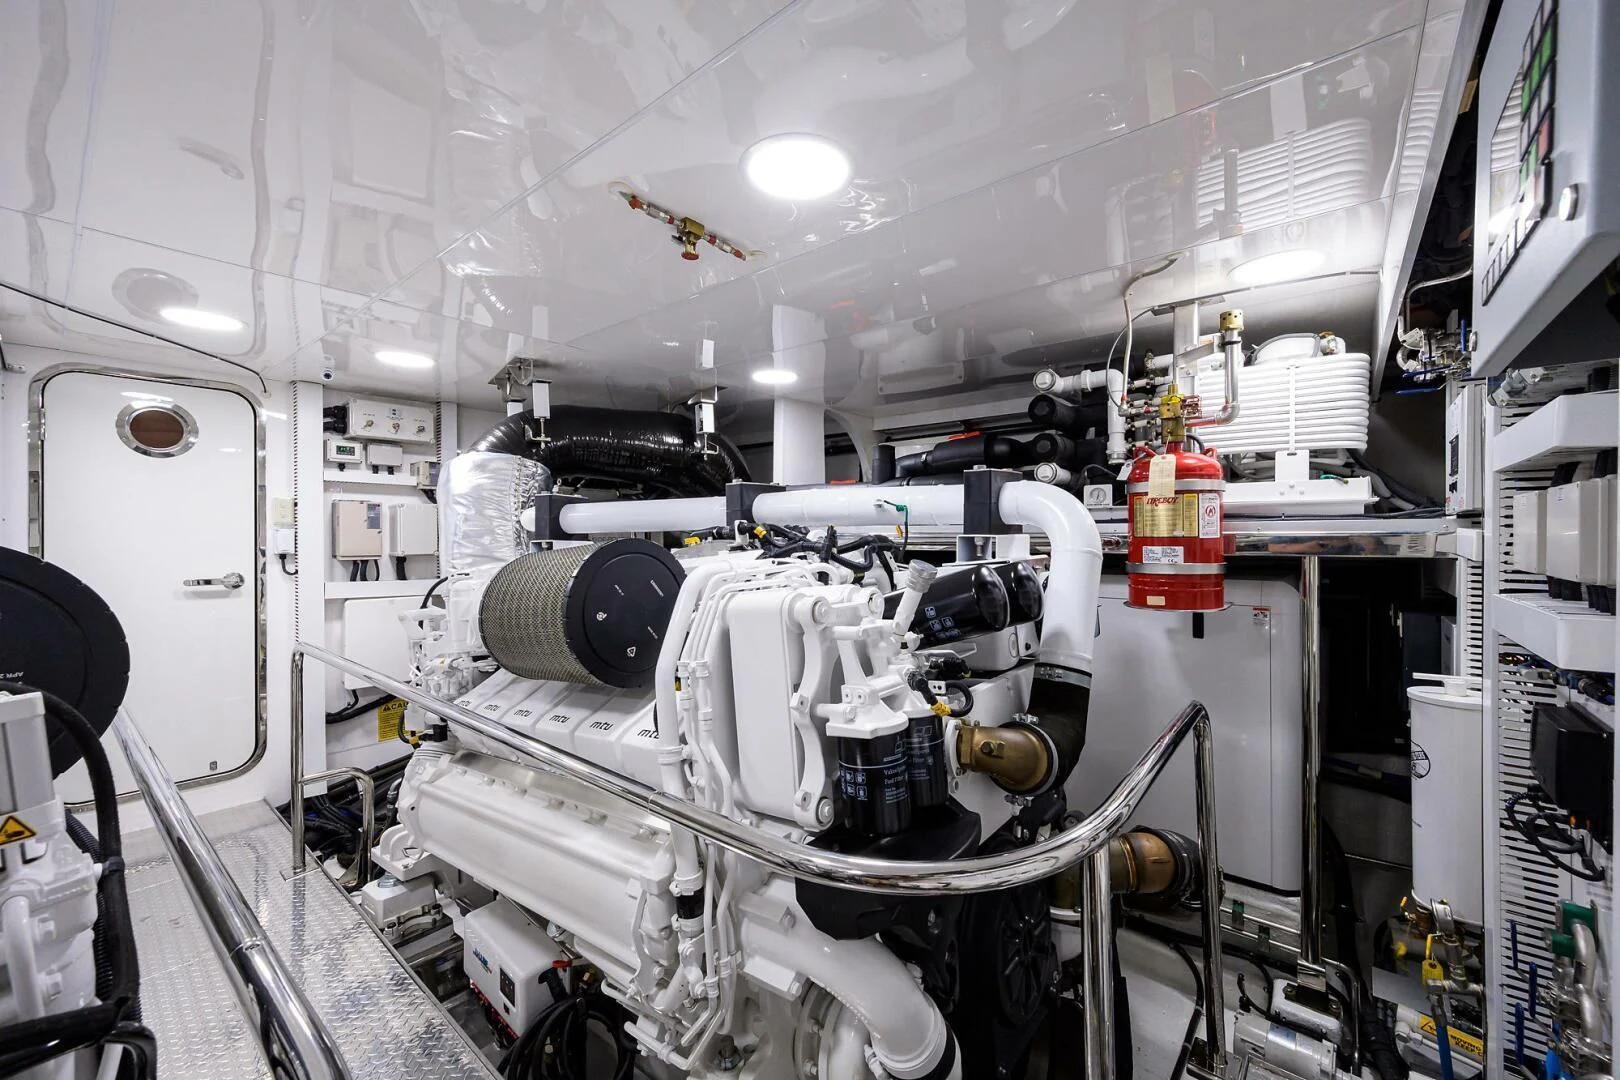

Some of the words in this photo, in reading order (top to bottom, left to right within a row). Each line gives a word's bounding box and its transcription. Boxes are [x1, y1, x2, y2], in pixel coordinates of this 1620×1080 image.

[513, 709, 532, 717] mtu
[549, 715, 570, 723] mtu
[589, 721, 614, 731] mtu
